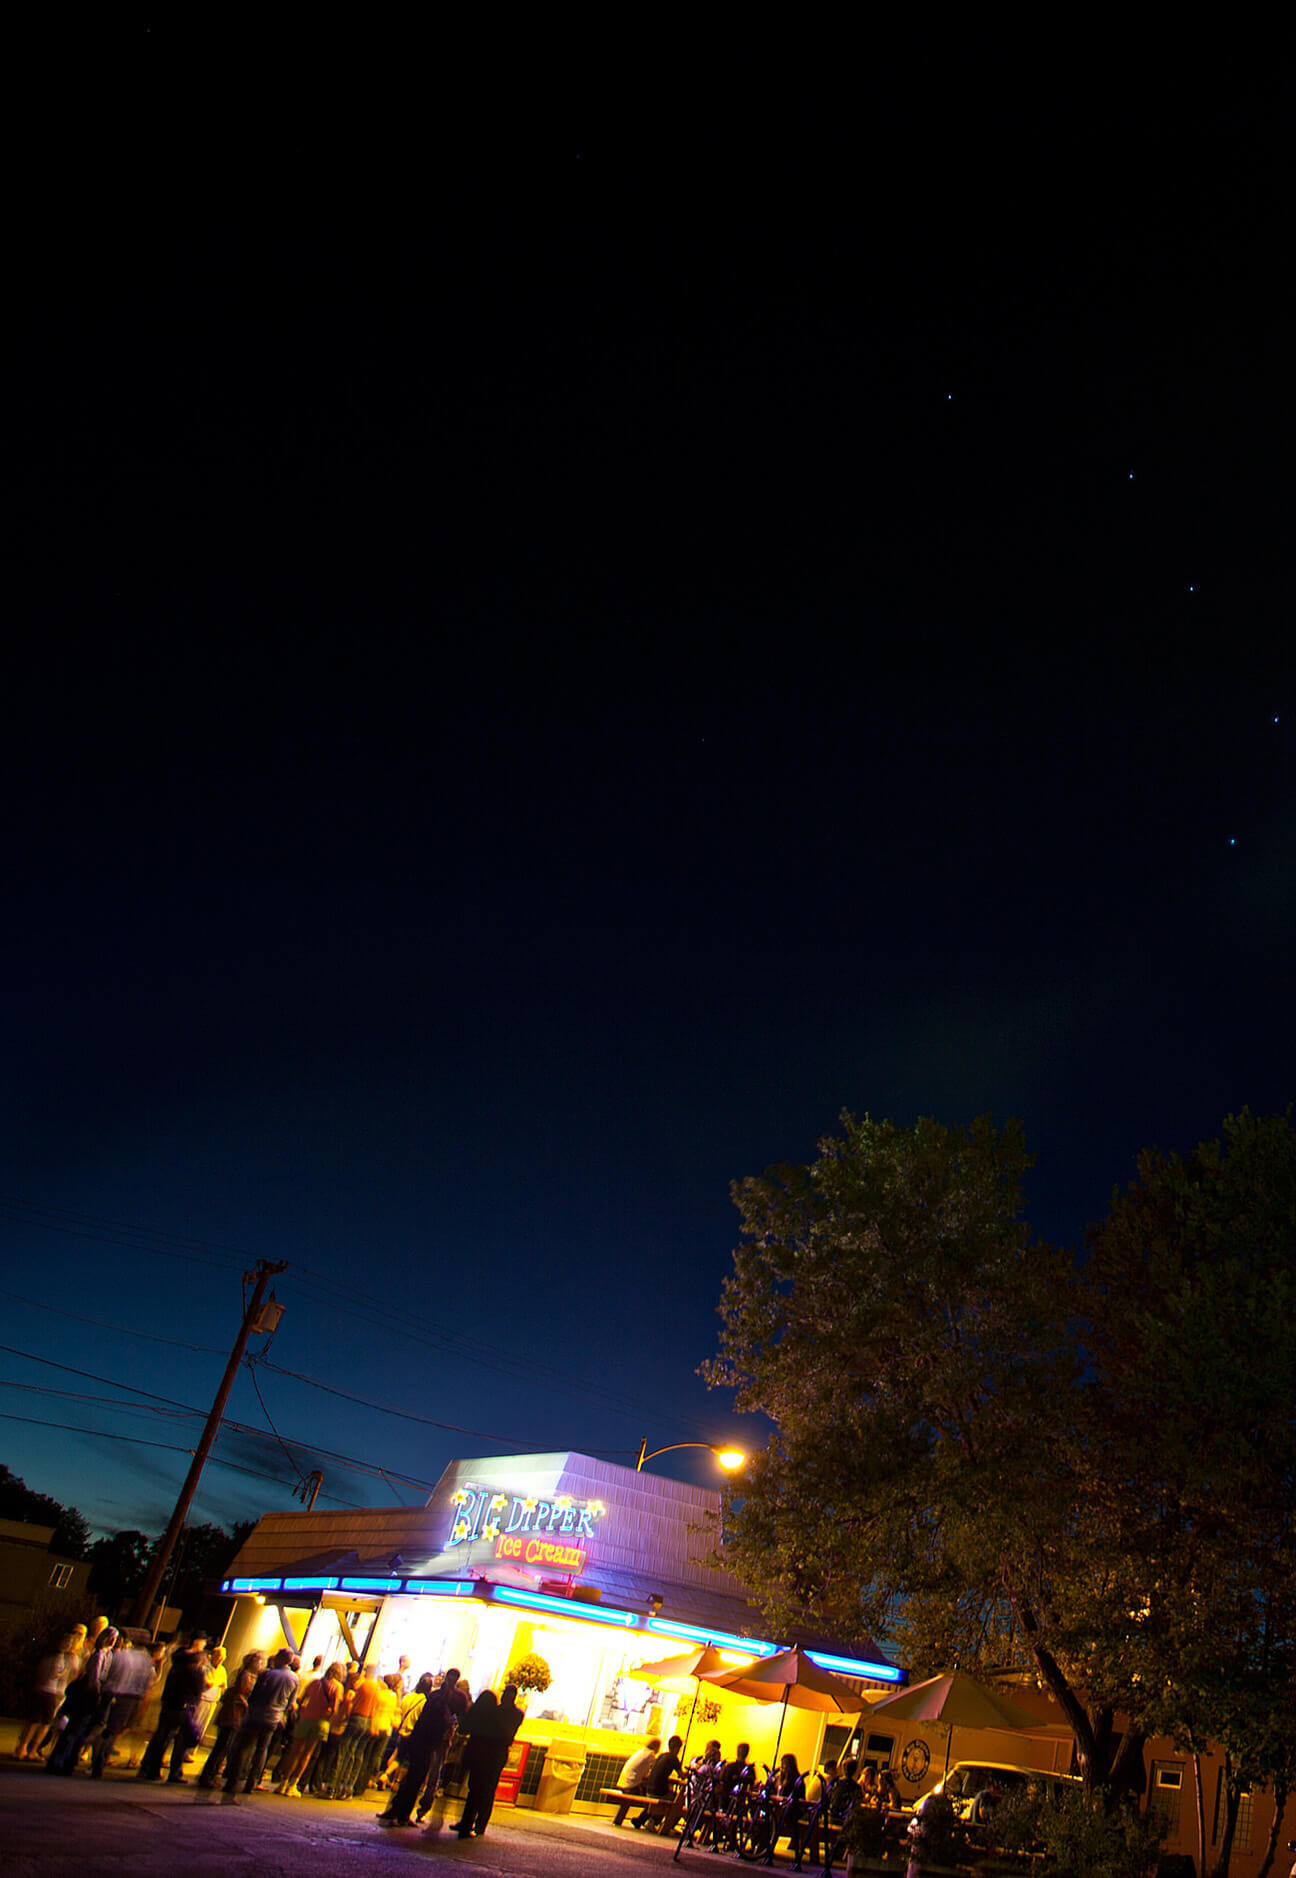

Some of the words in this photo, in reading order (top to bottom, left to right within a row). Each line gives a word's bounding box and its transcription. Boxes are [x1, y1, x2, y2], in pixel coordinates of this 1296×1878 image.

[443, 1488, 501, 1551] BIG
[495, 1533, 522, 1559] Ice
[525, 1540, 581, 1567] Cream
